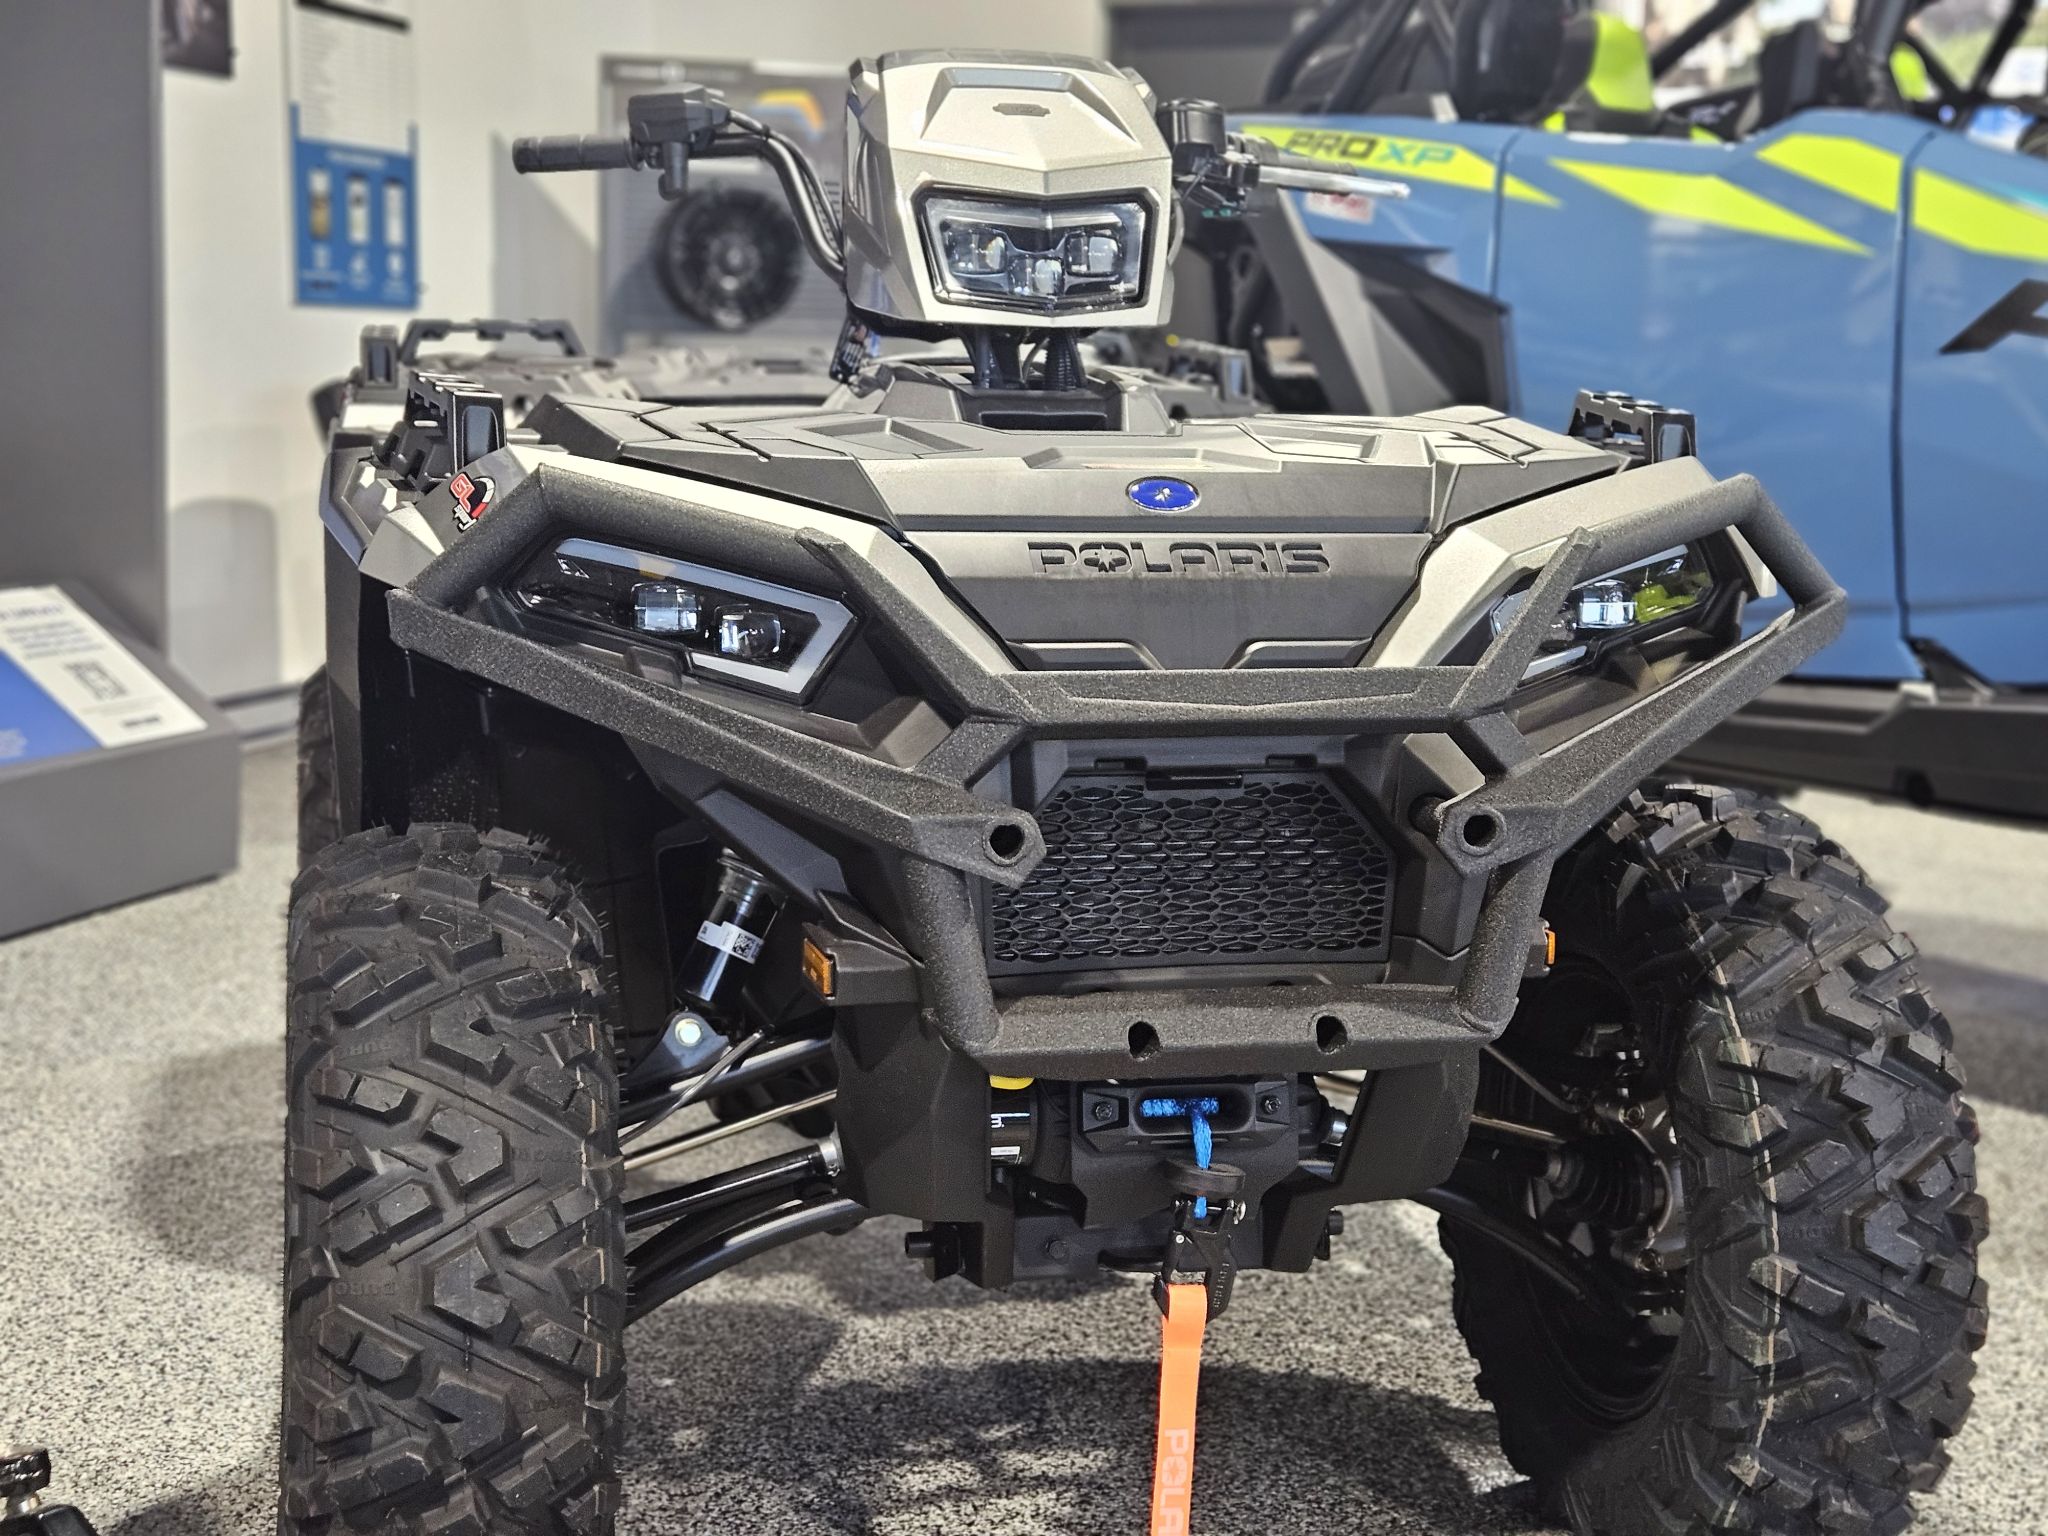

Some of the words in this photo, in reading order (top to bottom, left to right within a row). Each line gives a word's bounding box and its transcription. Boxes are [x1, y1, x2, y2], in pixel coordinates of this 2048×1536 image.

[1286, 130, 1377, 160] PRO
[1376, 143, 1457, 166] XP
[1028, 541, 1331, 574] POLARIS
